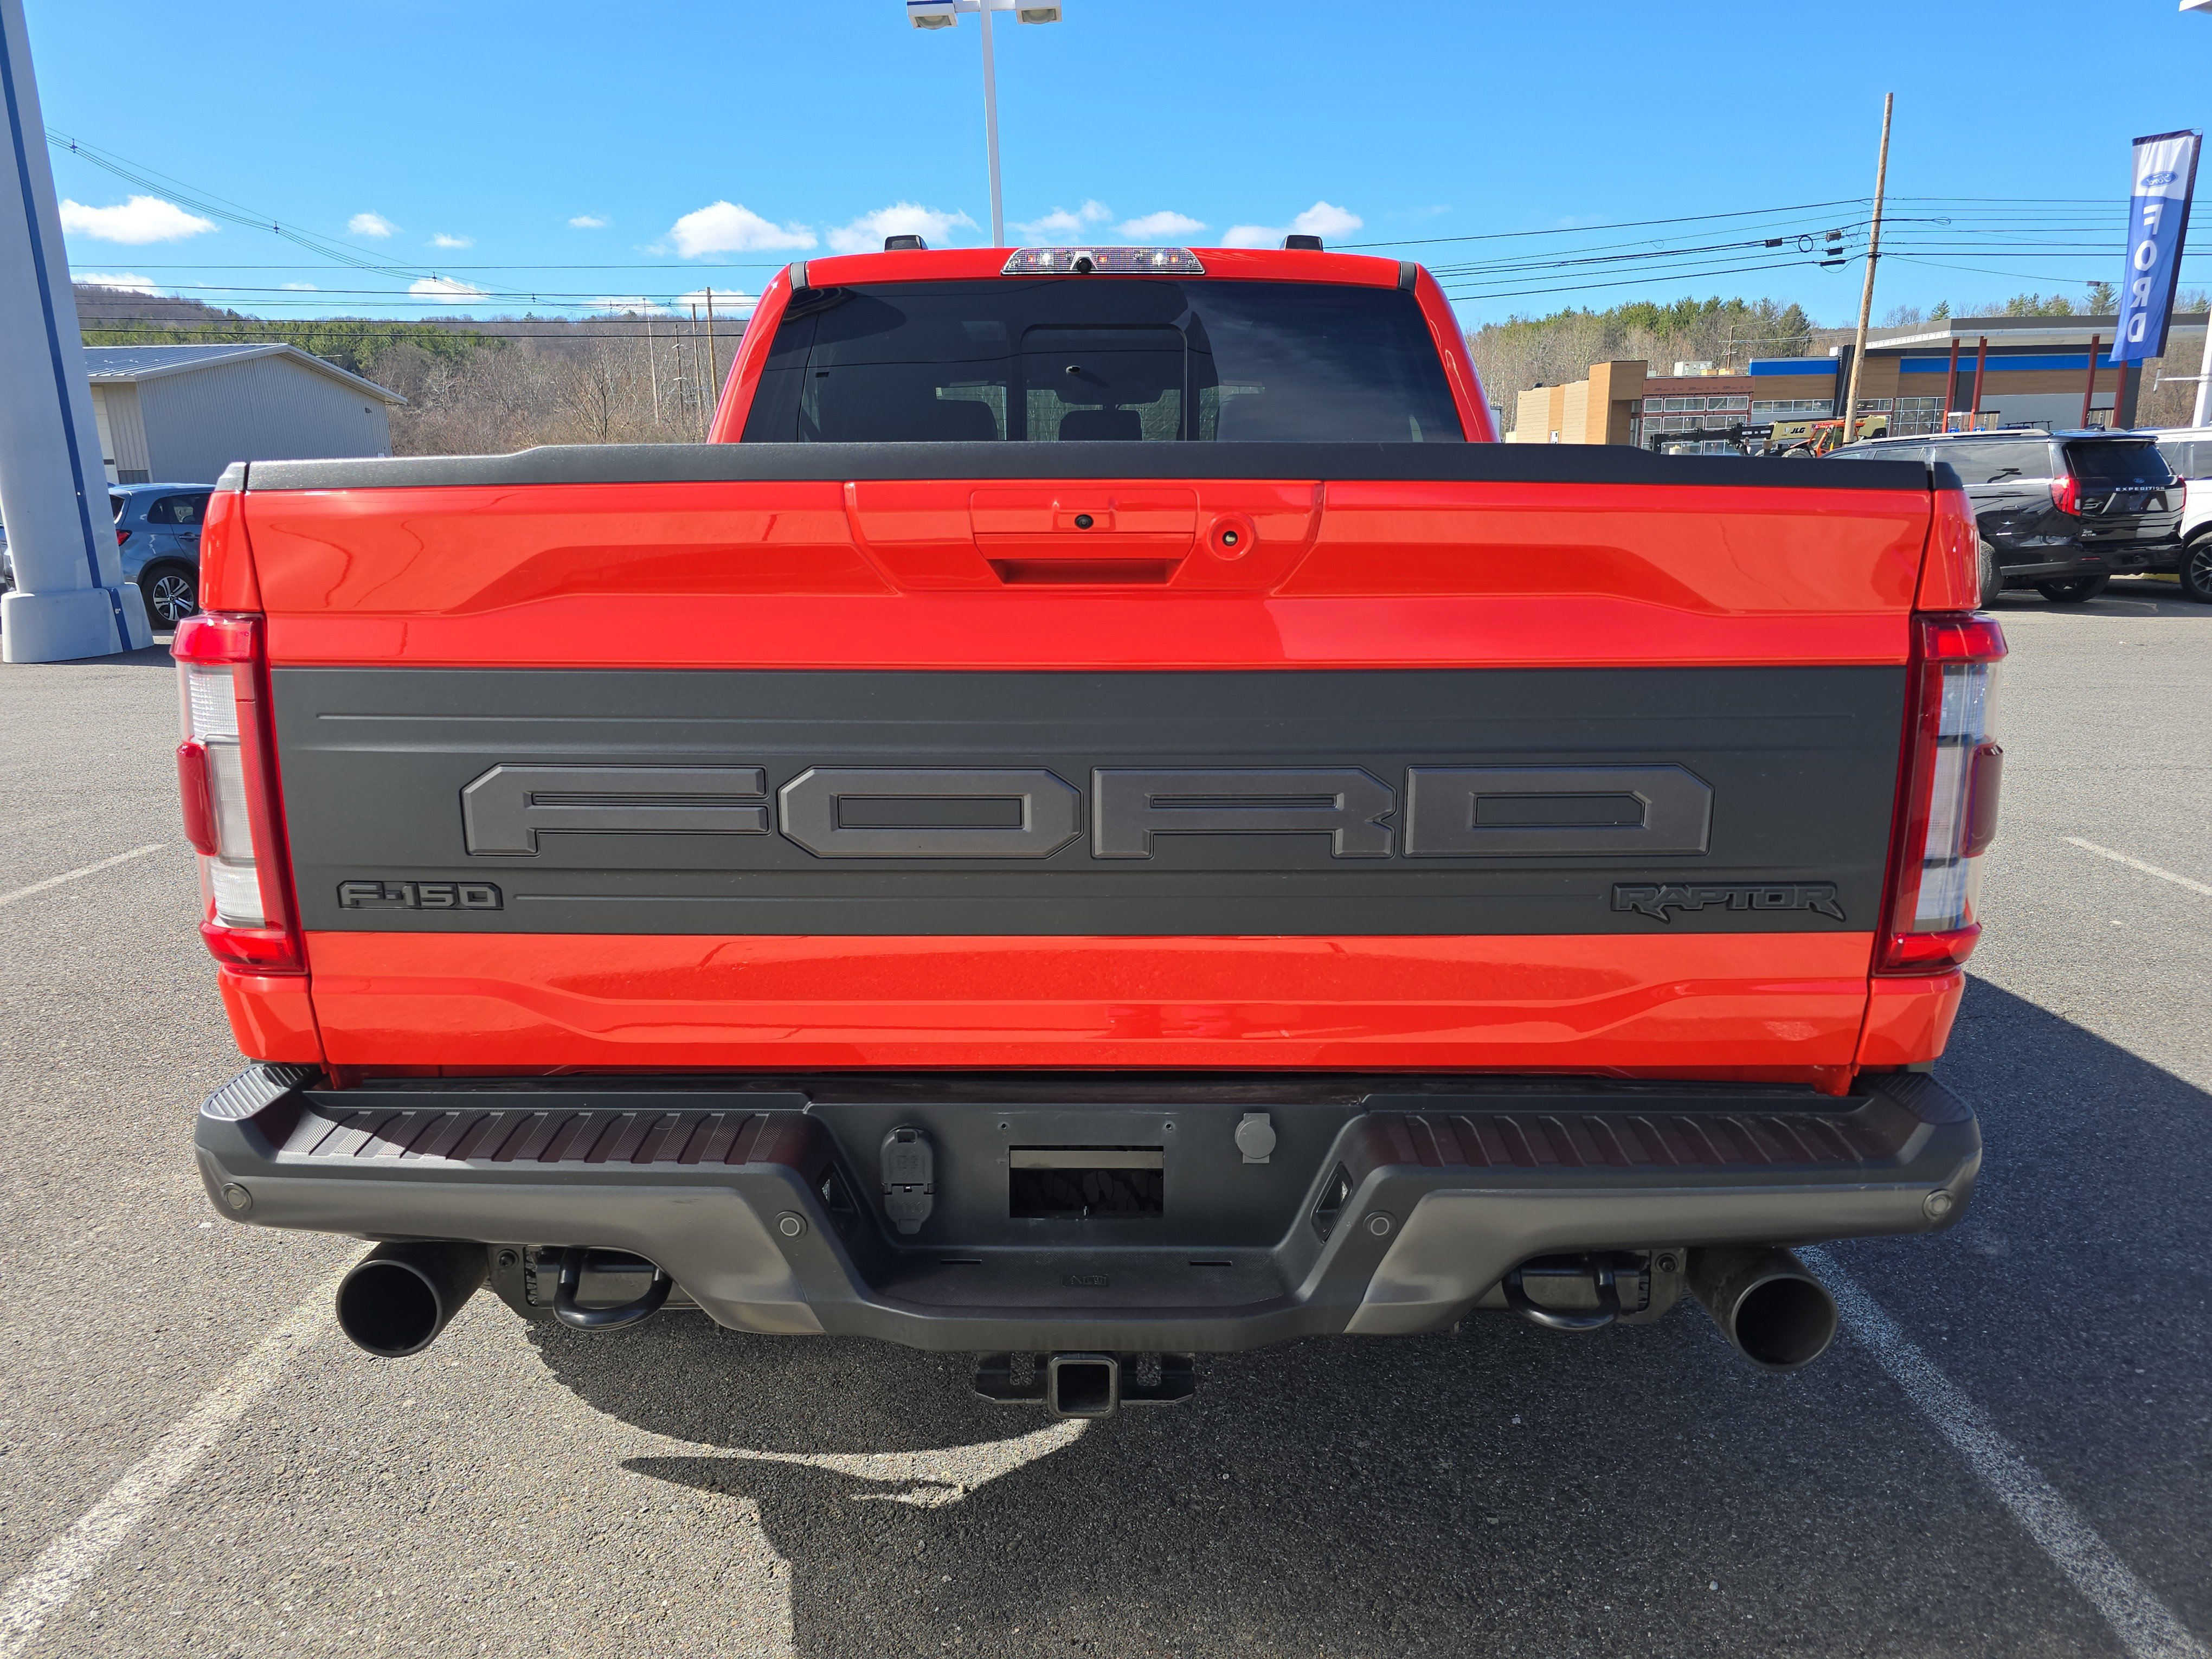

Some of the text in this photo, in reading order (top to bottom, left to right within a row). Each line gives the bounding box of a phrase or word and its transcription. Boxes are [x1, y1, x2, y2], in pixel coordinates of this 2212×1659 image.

[460, 763, 1715, 859] FORD
[337, 881, 504, 910] F-150
[1611, 882, 1846, 923] RAPTOR
